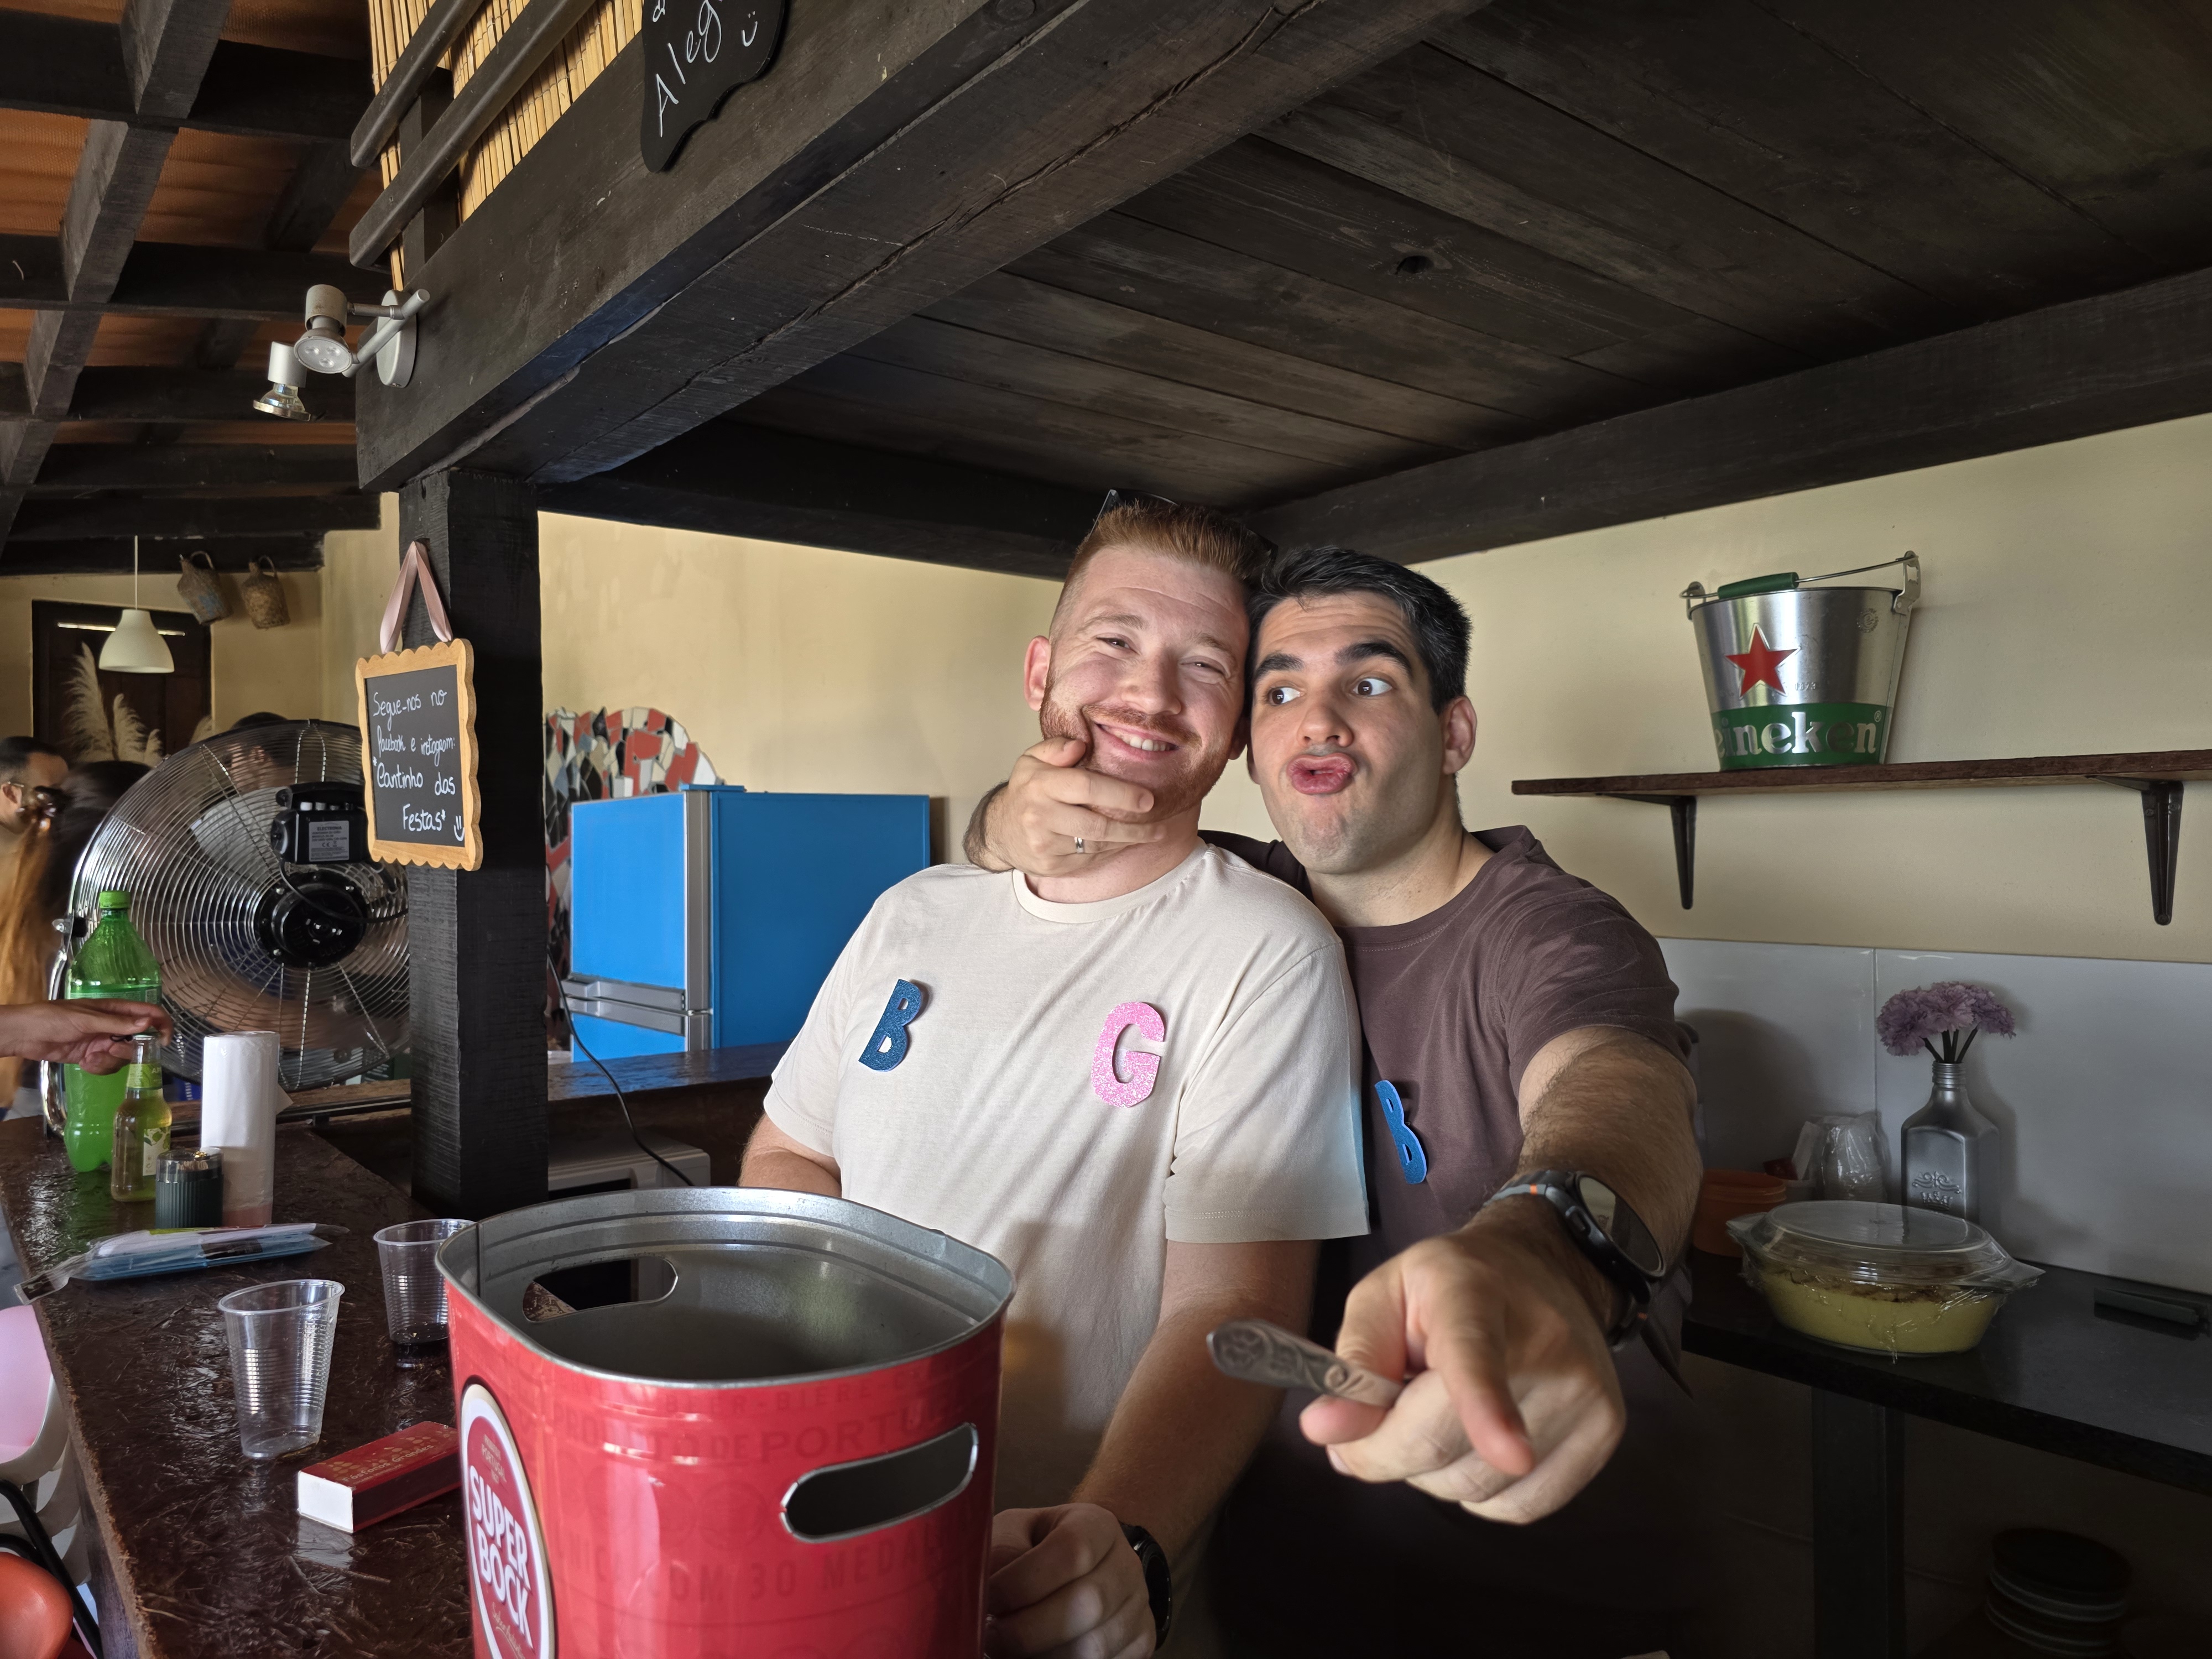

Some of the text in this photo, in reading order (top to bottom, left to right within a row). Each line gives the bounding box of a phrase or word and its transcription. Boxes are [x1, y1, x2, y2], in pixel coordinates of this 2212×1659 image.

[430, 689, 447, 707] no
[410, 737, 416, 752] e
[434, 771, 456, 796] das
[858, 979, 1165, 1108] B G
[1374, 1079, 1428, 1185] B
[392, 1444, 435, 1463] Grandes
[469, 1465, 531, 1589] SUPER
[476, 1523, 534, 1649] BOCK
